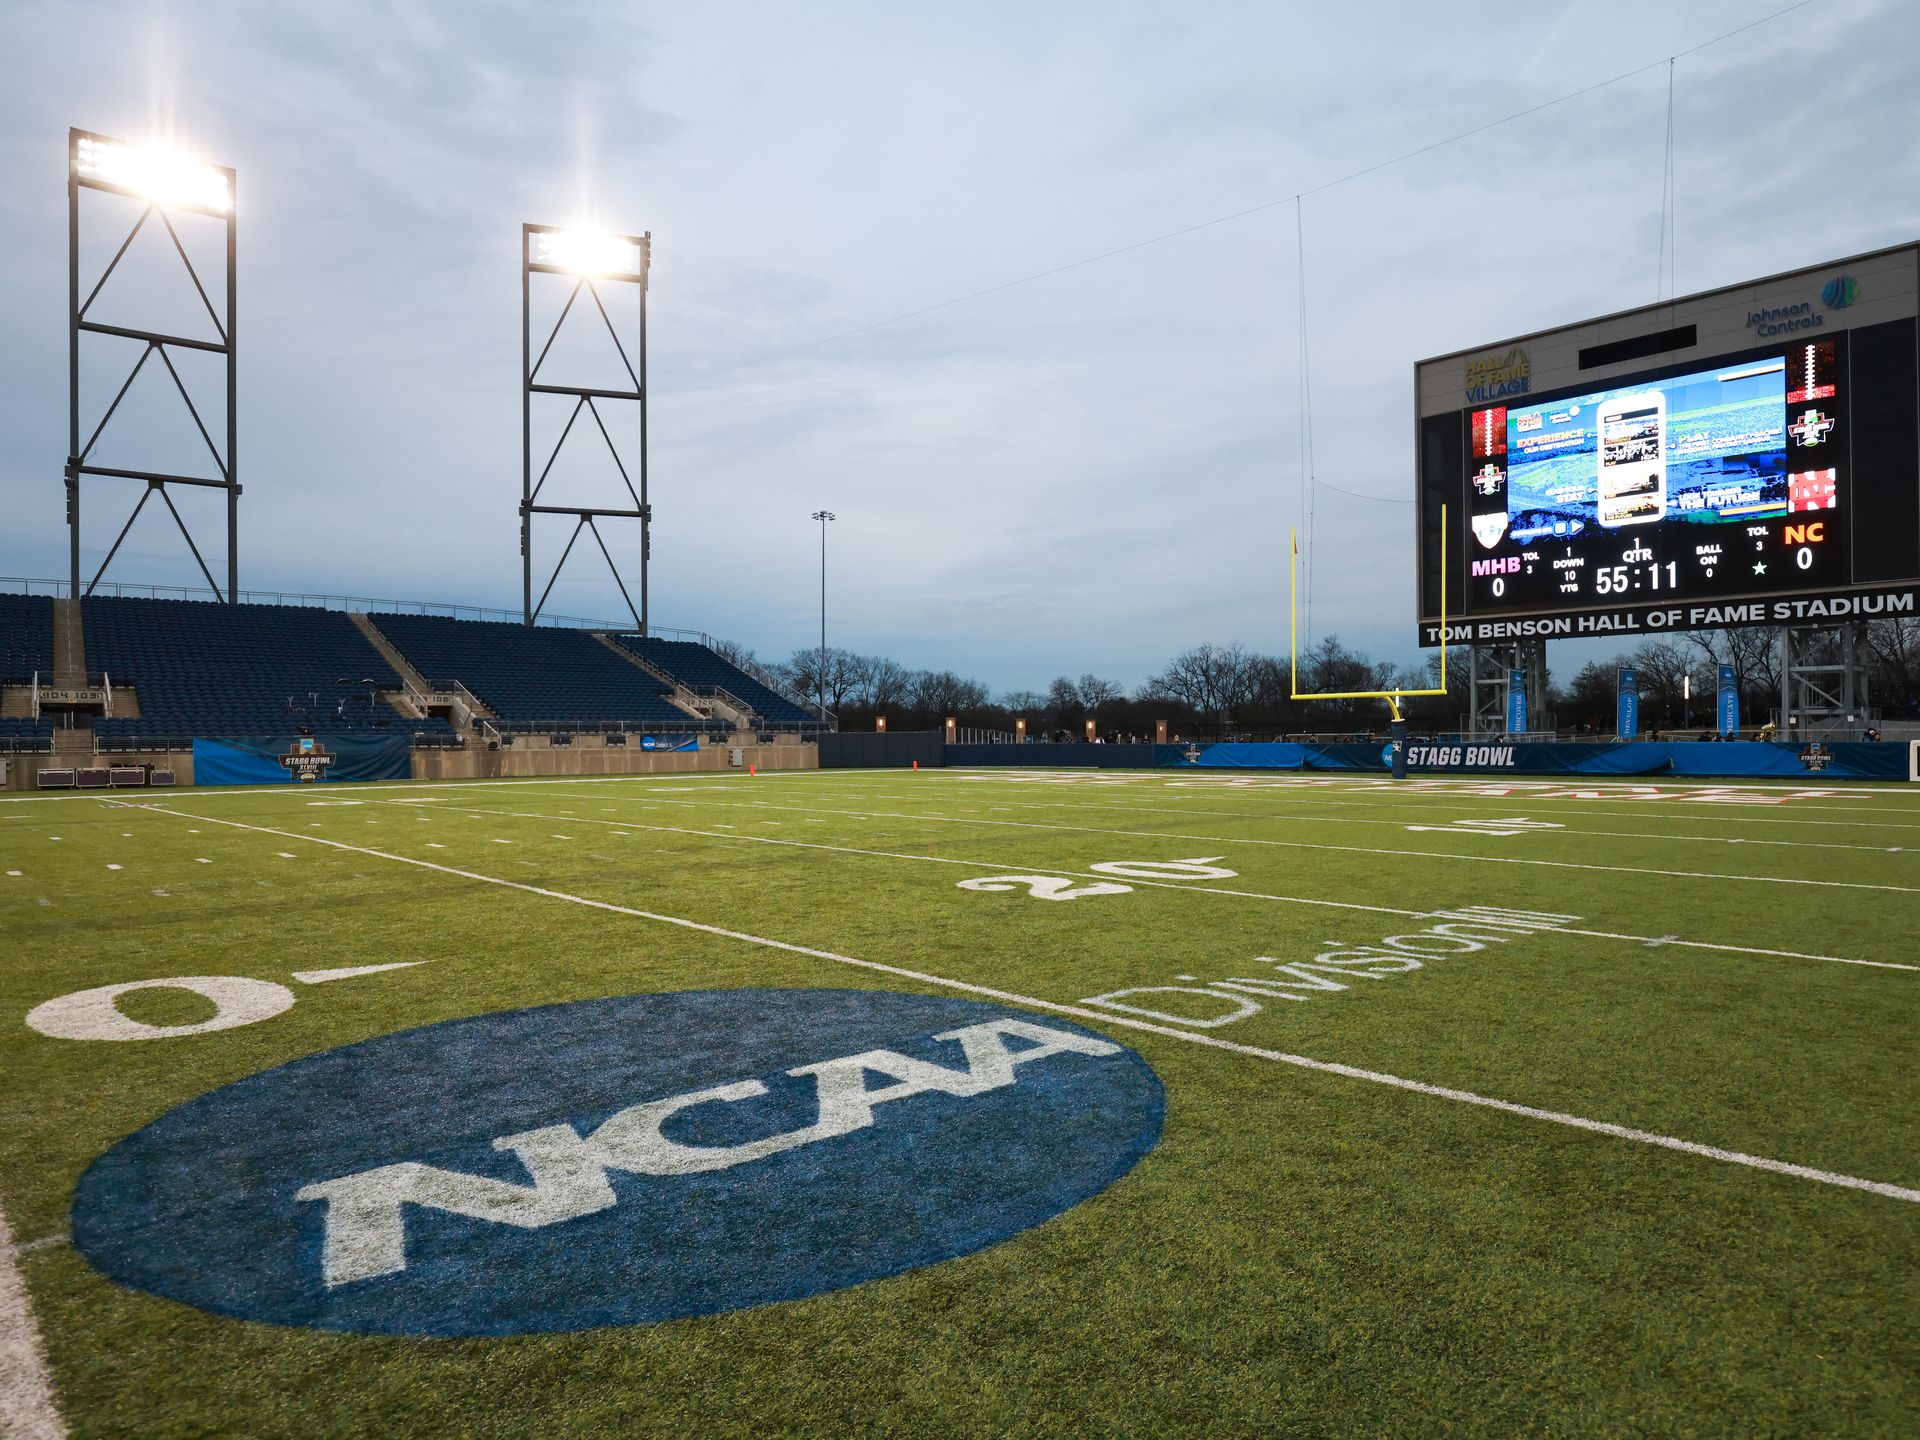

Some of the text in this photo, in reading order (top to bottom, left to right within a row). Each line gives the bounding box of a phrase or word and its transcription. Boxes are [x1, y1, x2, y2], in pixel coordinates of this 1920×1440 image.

[1746, 302, 1810, 328] Johnson
[1757, 312, 1825, 337] Controls
[1464, 353, 1502, 373] HALL
[1465, 363, 1530, 388] OF FAME
[1466, 378, 1532, 403] VILLAGE
[1517, 428, 1585, 448] EXPERIENCE
[1523, 438, 1585, 455] OUR DESTINATION
[1678, 431, 1710, 444] PLAY
[1679, 491, 1760, 511] THE FUTURE
[1746, 526, 1769, 537] TOL
[1784, 522, 1824, 545] NC
[1566, 546, 1572, 557] 1
[1633, 537, 1640, 549] 1
[1695, 544, 1722, 555] BALL
[1755, 541, 1763, 551] 3
[1522, 552, 1540, 561] TOL
[1553, 557, 1584, 569] DOWN
[1622, 548, 1653, 563] QTR
[1700, 555, 1718, 565] ON
[1796, 547, 1813, 570] 0
[1472, 556, 1521, 577] MHB
[1526, 565, 1533, 575] 3
[1564, 570, 1576, 581] 10
[1706, 568, 1713, 578] 0
[1492, 578, 1505, 597] 0
[1596, 561, 1677, 594] 55:11
[1559, 583, 1579, 593] YTG
[1426, 593, 1914, 642] TOM BENSON HALL OF FAME STADIUM
[1515, 695, 1523, 731] DISCOVER
[1624, 697, 1633, 734] DEVELOP
[1726, 692, 1734, 735] DEDICATE
[285, 756, 331, 766] STAGG BOWL
[1406, 746, 1515, 766] STAGG BOWL
[1078, 923, 1535, 1029] Division
[23, 975, 296, 1042] 0
[295, 1017, 1123, 1289] NCAA
